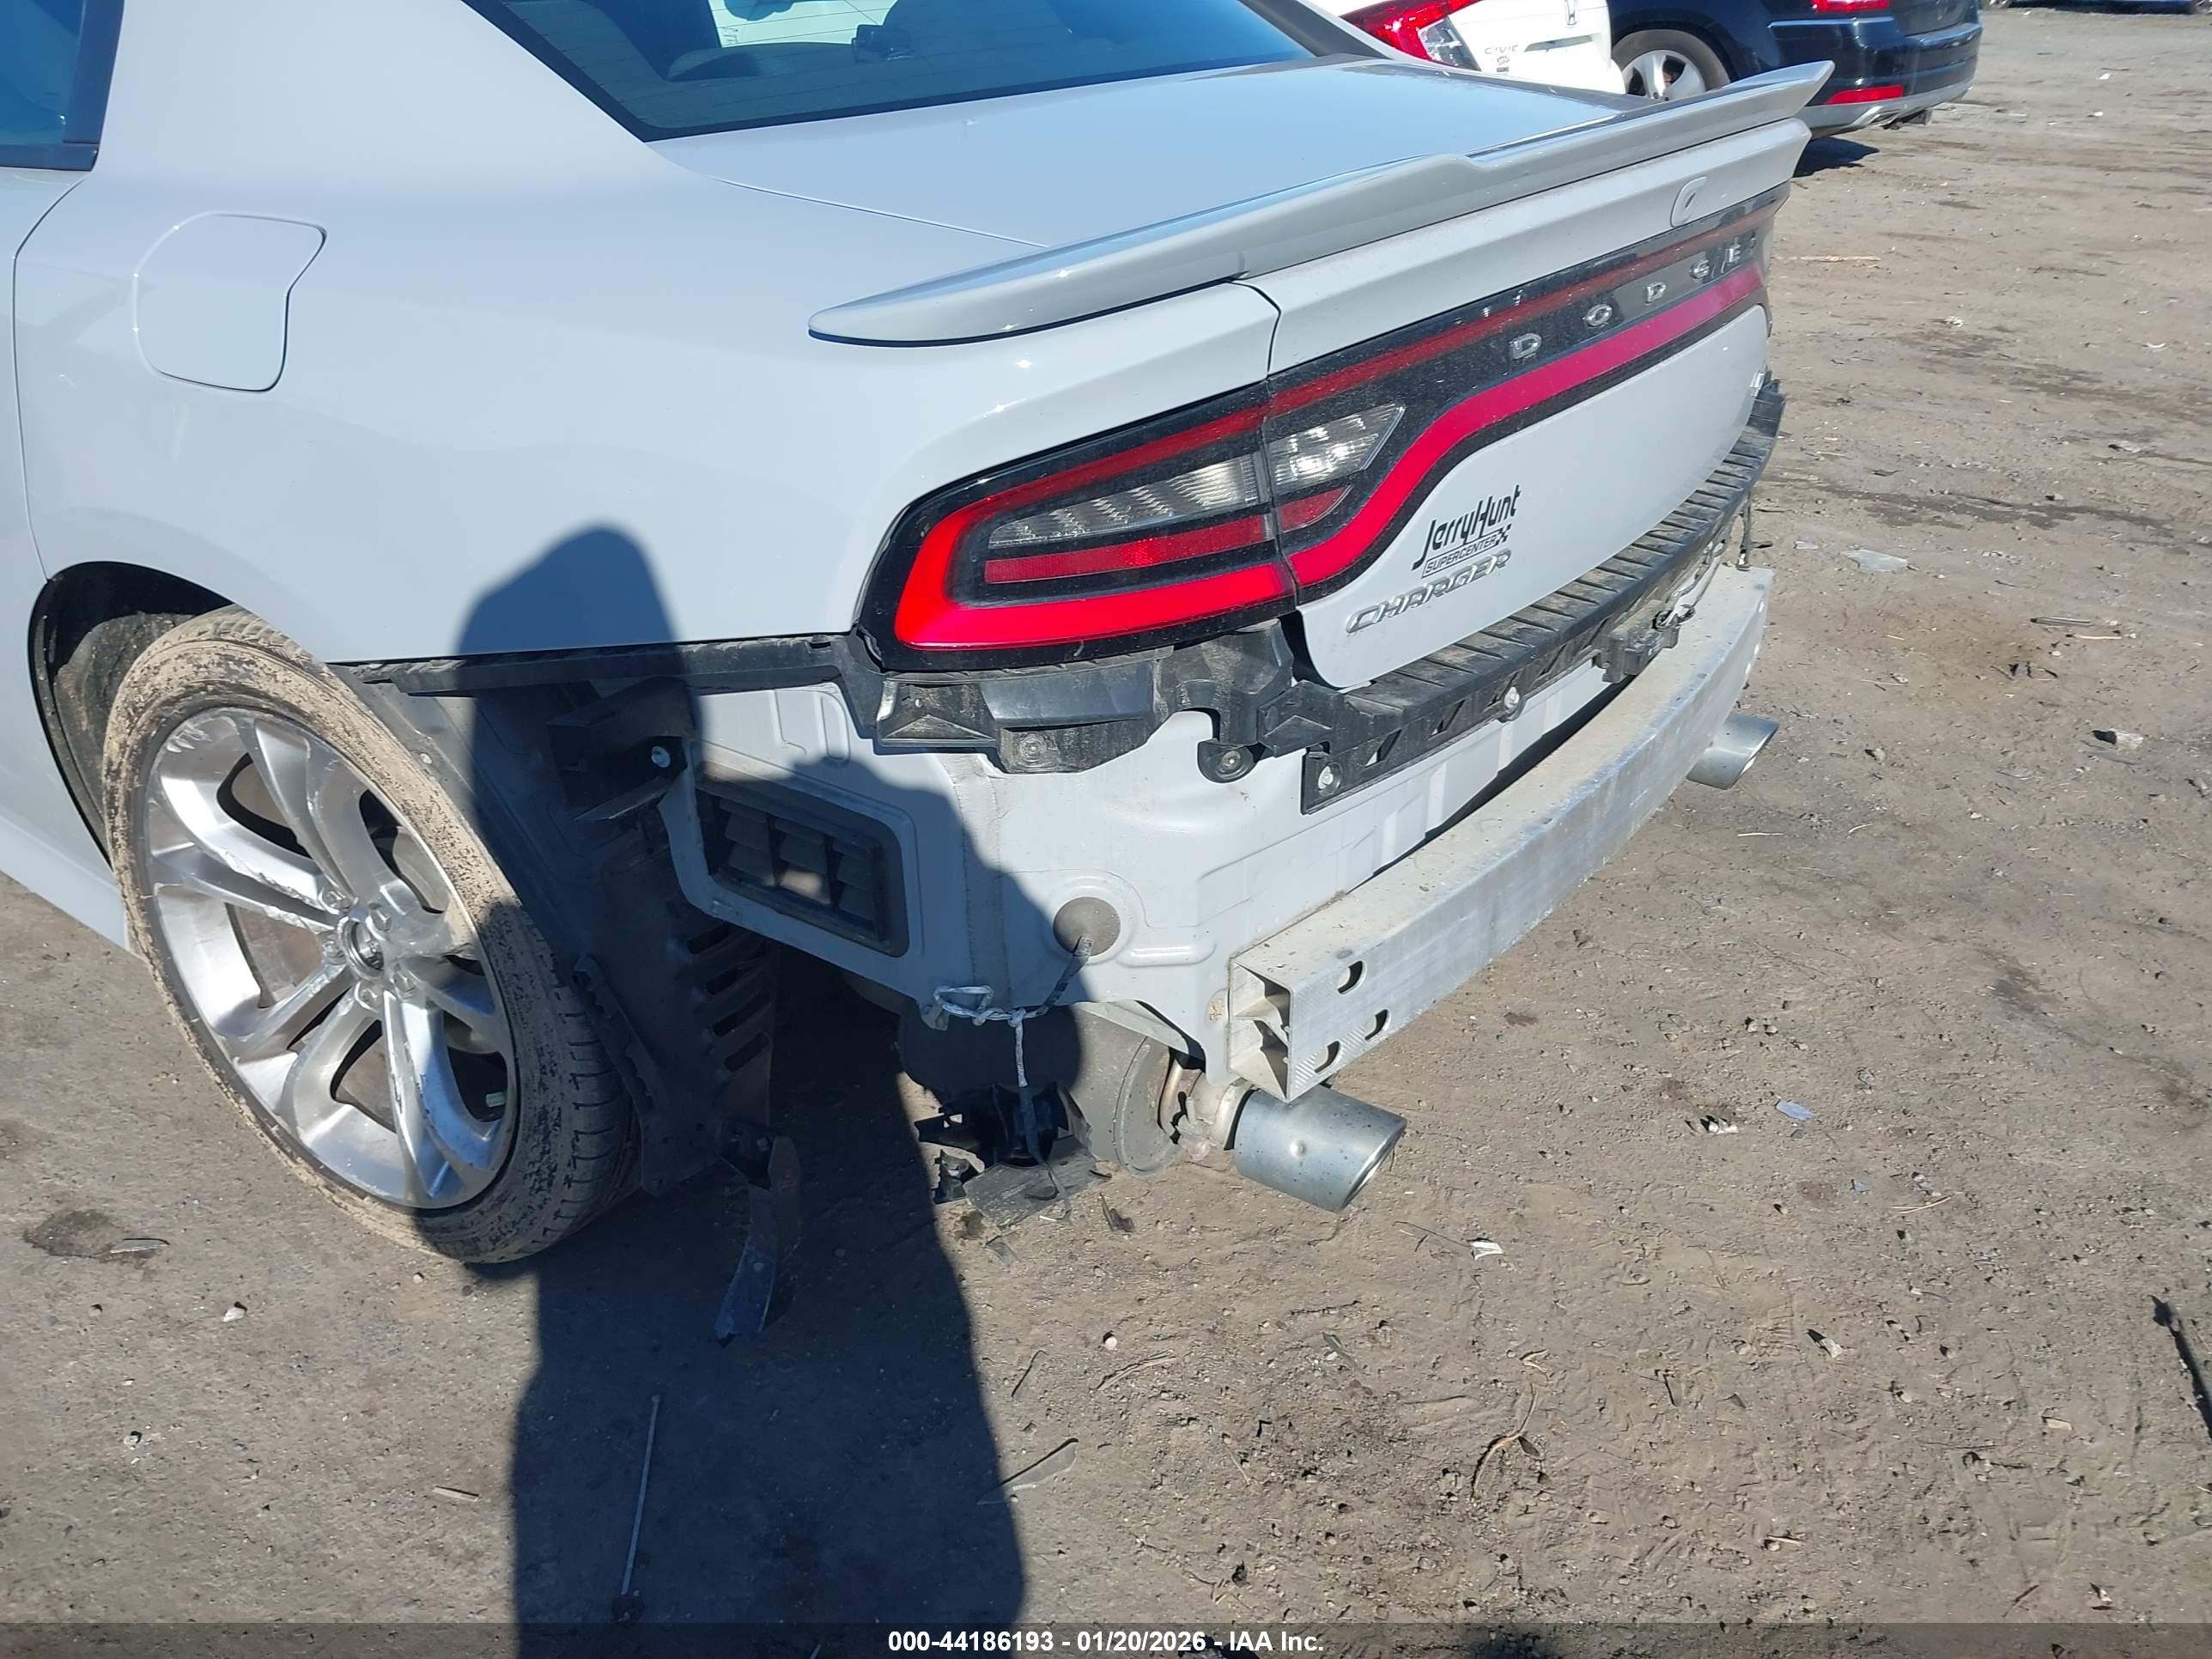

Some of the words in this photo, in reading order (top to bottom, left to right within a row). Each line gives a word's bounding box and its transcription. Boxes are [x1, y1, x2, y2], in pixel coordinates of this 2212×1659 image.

[1484, 45, 1519, 55] CIVIC
[1509, 242, 1741, 359] DODGE
[1425, 534, 1497, 574] SUPERCENTER
[1346, 548, 1511, 633] CHARGER
